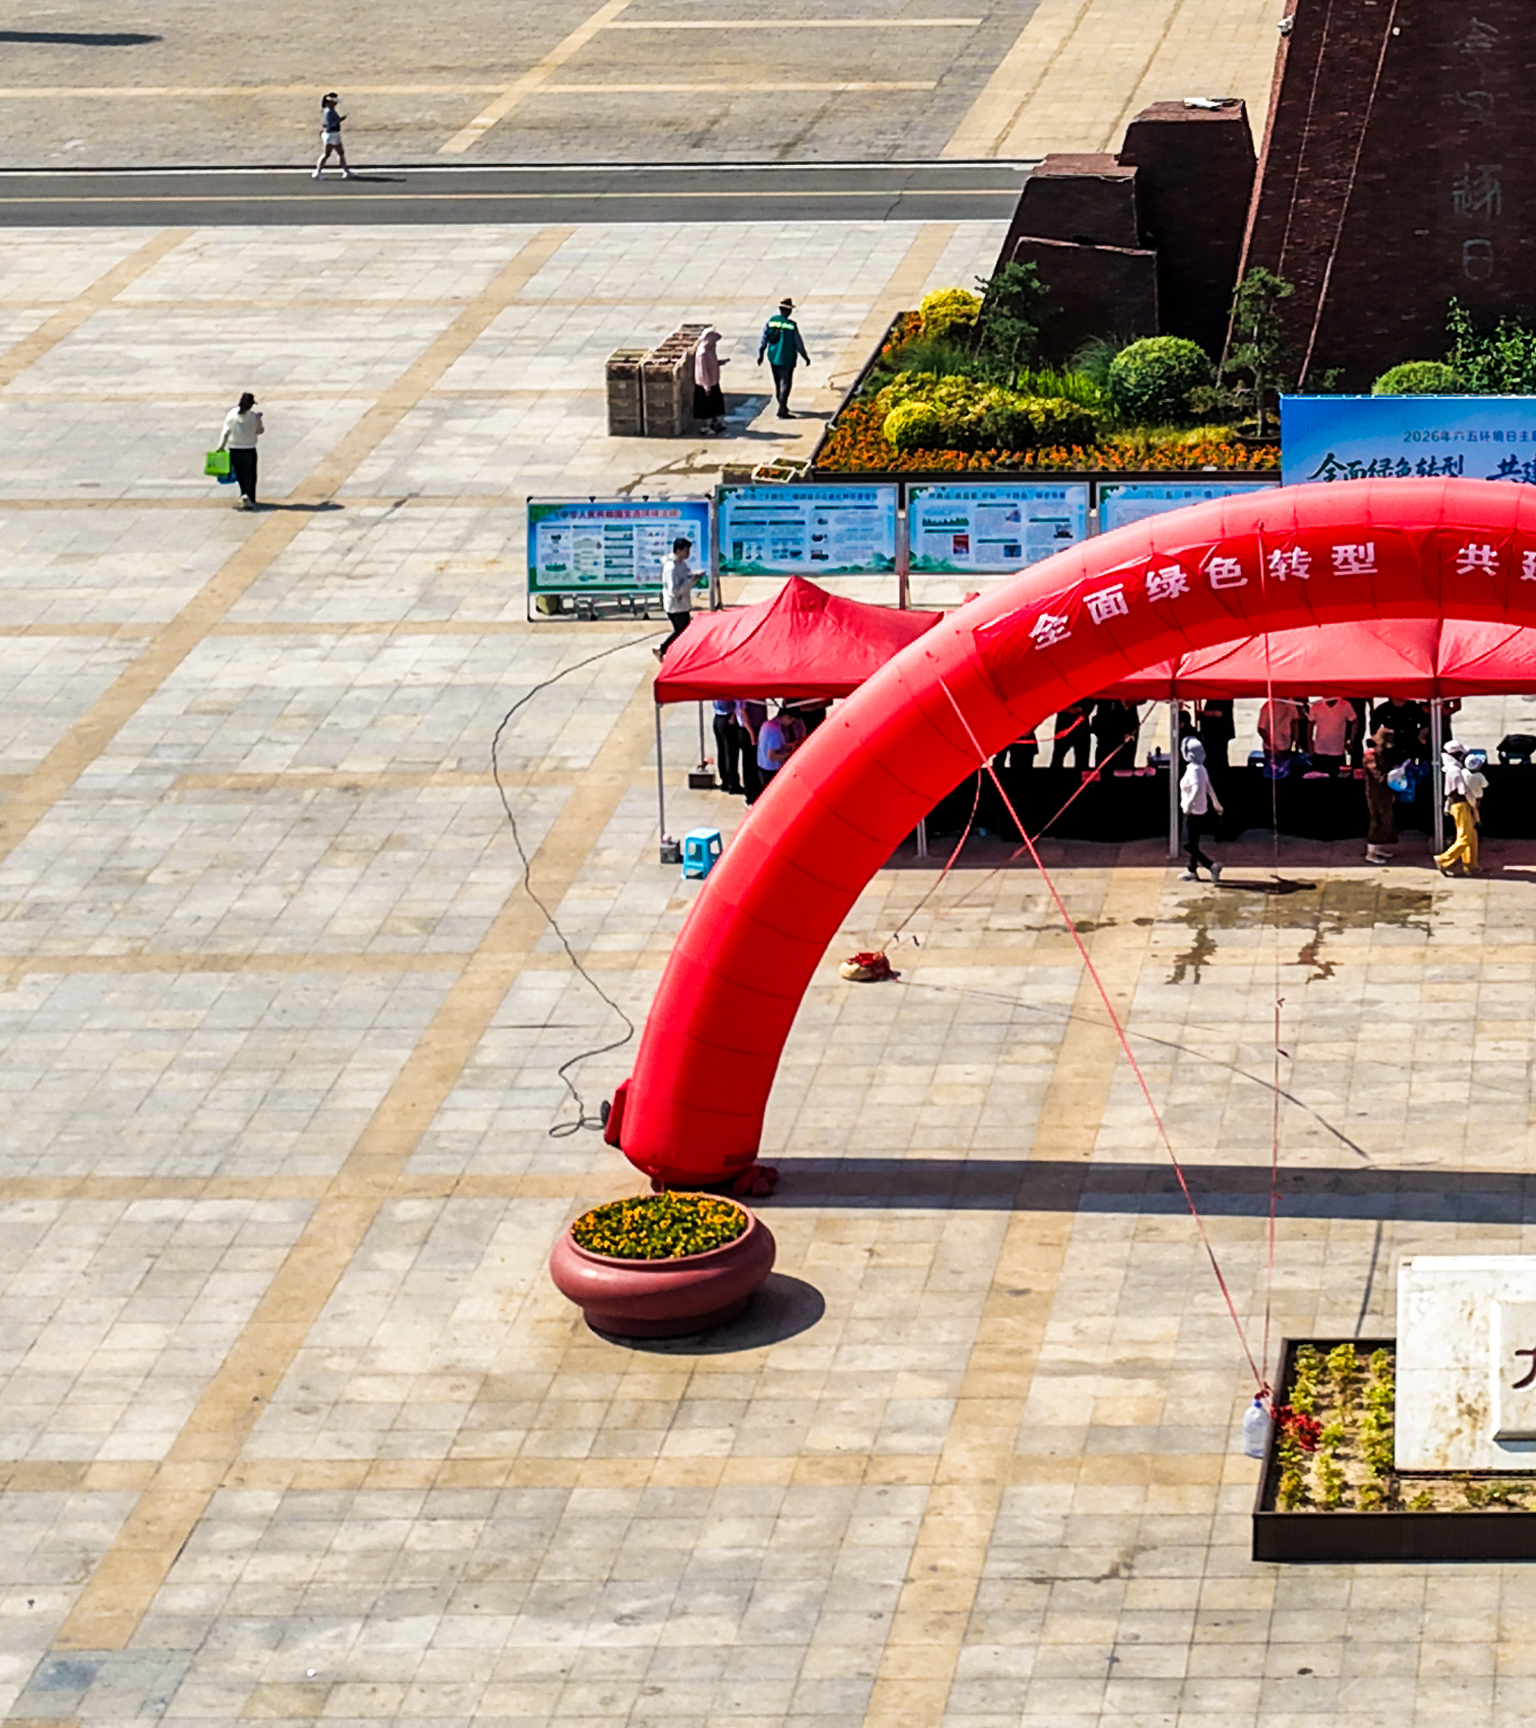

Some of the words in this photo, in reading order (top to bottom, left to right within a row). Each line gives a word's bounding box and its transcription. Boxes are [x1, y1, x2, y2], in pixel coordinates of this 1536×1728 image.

[1307, 452, 1465, 482] 全面绿色转型
[1028, 541, 1378, 650] 全面绿色转型
